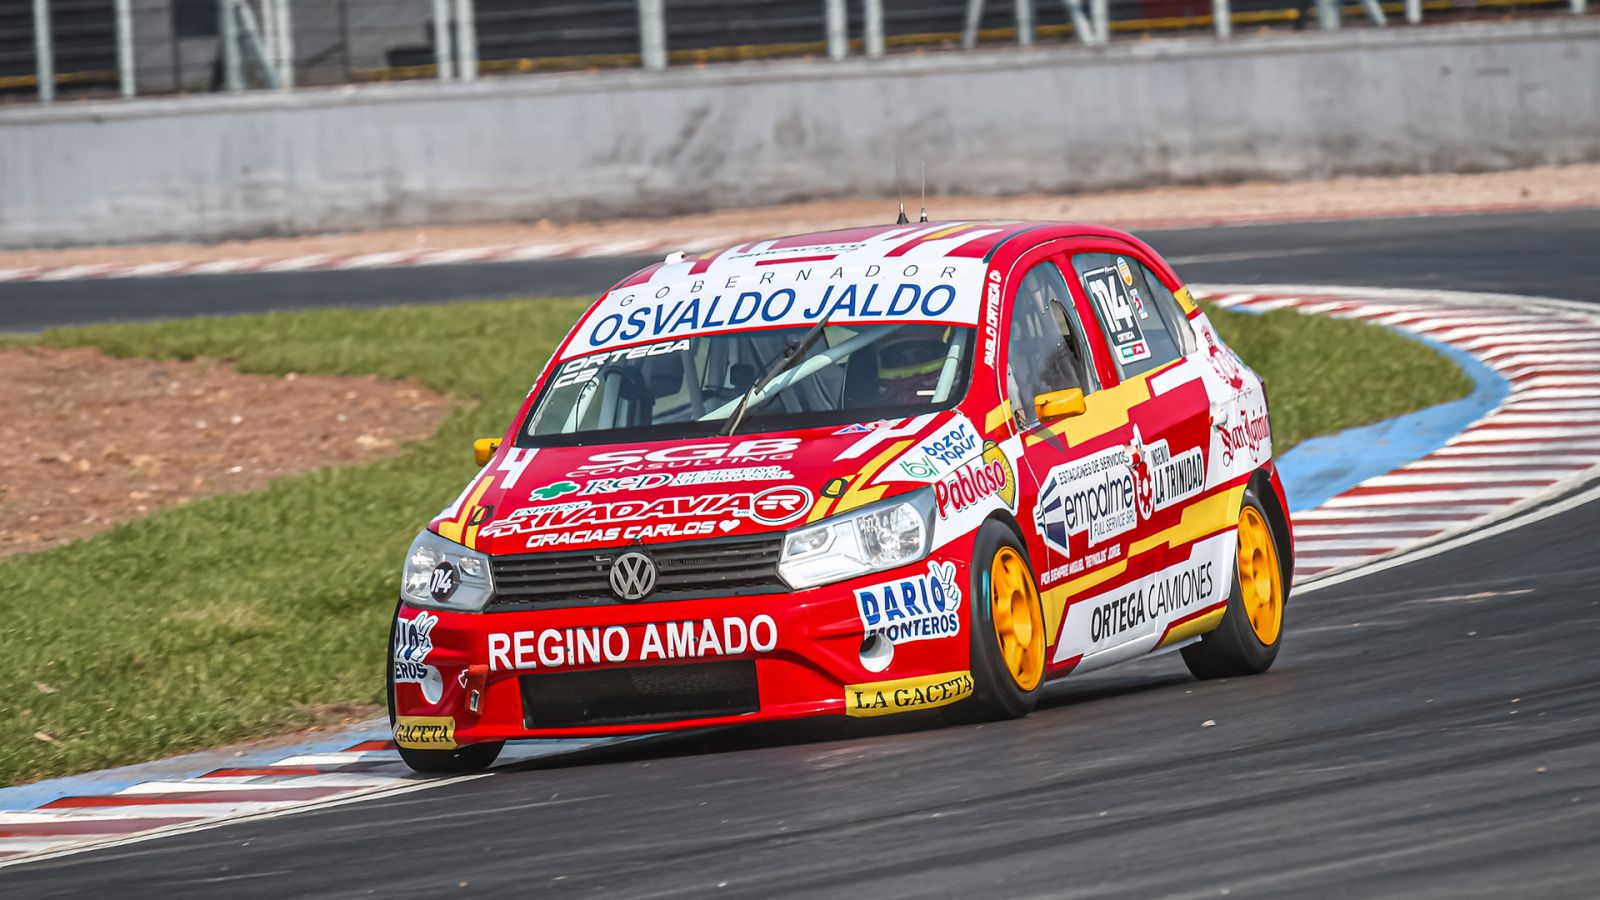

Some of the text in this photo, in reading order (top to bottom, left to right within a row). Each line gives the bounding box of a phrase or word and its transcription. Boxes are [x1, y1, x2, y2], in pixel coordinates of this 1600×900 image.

[620, 264, 957, 307] GOBERNADOR
[986, 283, 1001, 329] ORTEGA
[588, 282, 957, 347] OSVALDO JALDO
[563, 339, 690, 375] ORTEGA
[984, 325, 997, 370] PABLO
[577, 438, 803, 471] SGB
[922, 423, 965, 457] bazar
[936, 433, 977, 466] yapur
[566, 454, 794, 478] CONSULTING
[1154, 453, 1204, 505] LA TRINIDAD
[513, 502, 589, 516] EXPRESO
[934, 460, 1007, 520] Pabloso
[1064, 471, 1133, 541] empalme
[479, 493, 751, 537] RIVADAVIA
[526, 520, 717, 549] GRACIAS CARLOS
[859, 575, 948, 626] DARIO
[1091, 561, 1213, 643] ORTEGA CAMIONES
[488, 614, 778, 672] REGINO AMADO
[854, 675, 973, 710] LA GACETA
